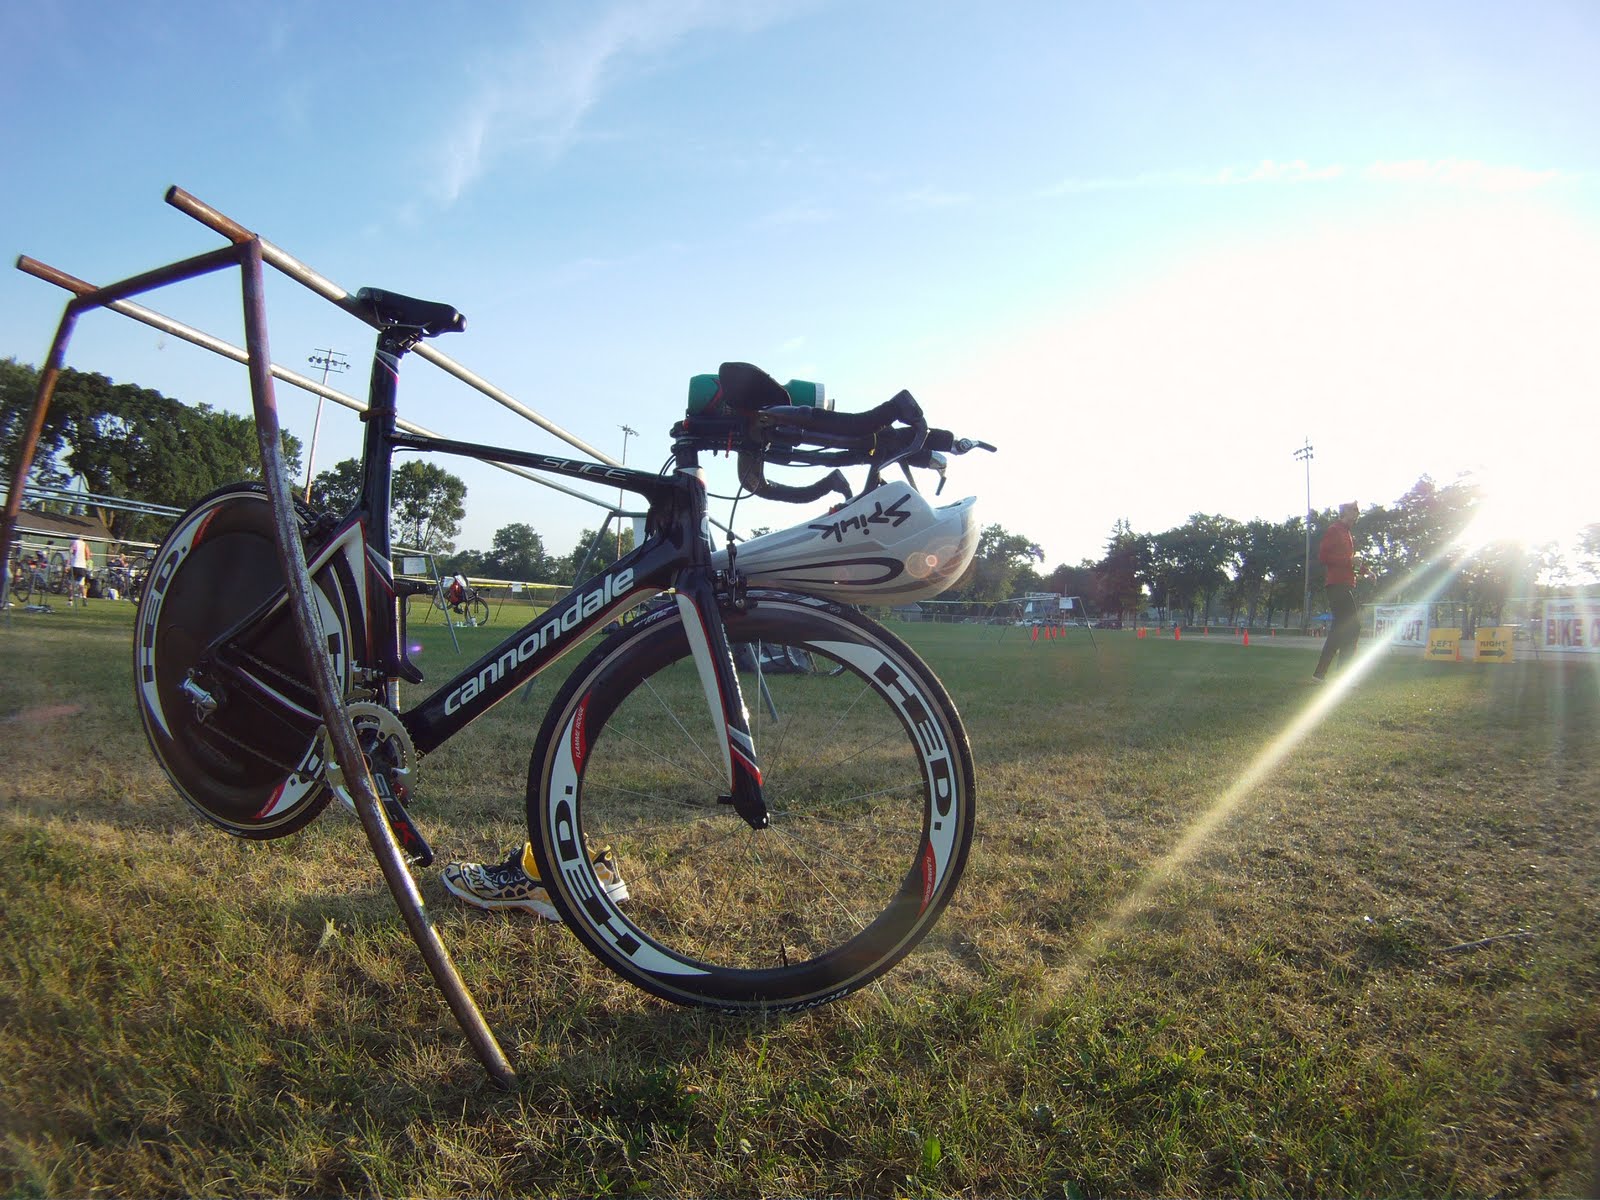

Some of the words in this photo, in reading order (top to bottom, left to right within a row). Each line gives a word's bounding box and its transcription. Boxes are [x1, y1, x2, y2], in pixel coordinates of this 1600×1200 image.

[539, 456, 629, 481] SLICE
[444, 567, 634, 716] cannondale
[1546, 618, 1584, 647] BIKE
